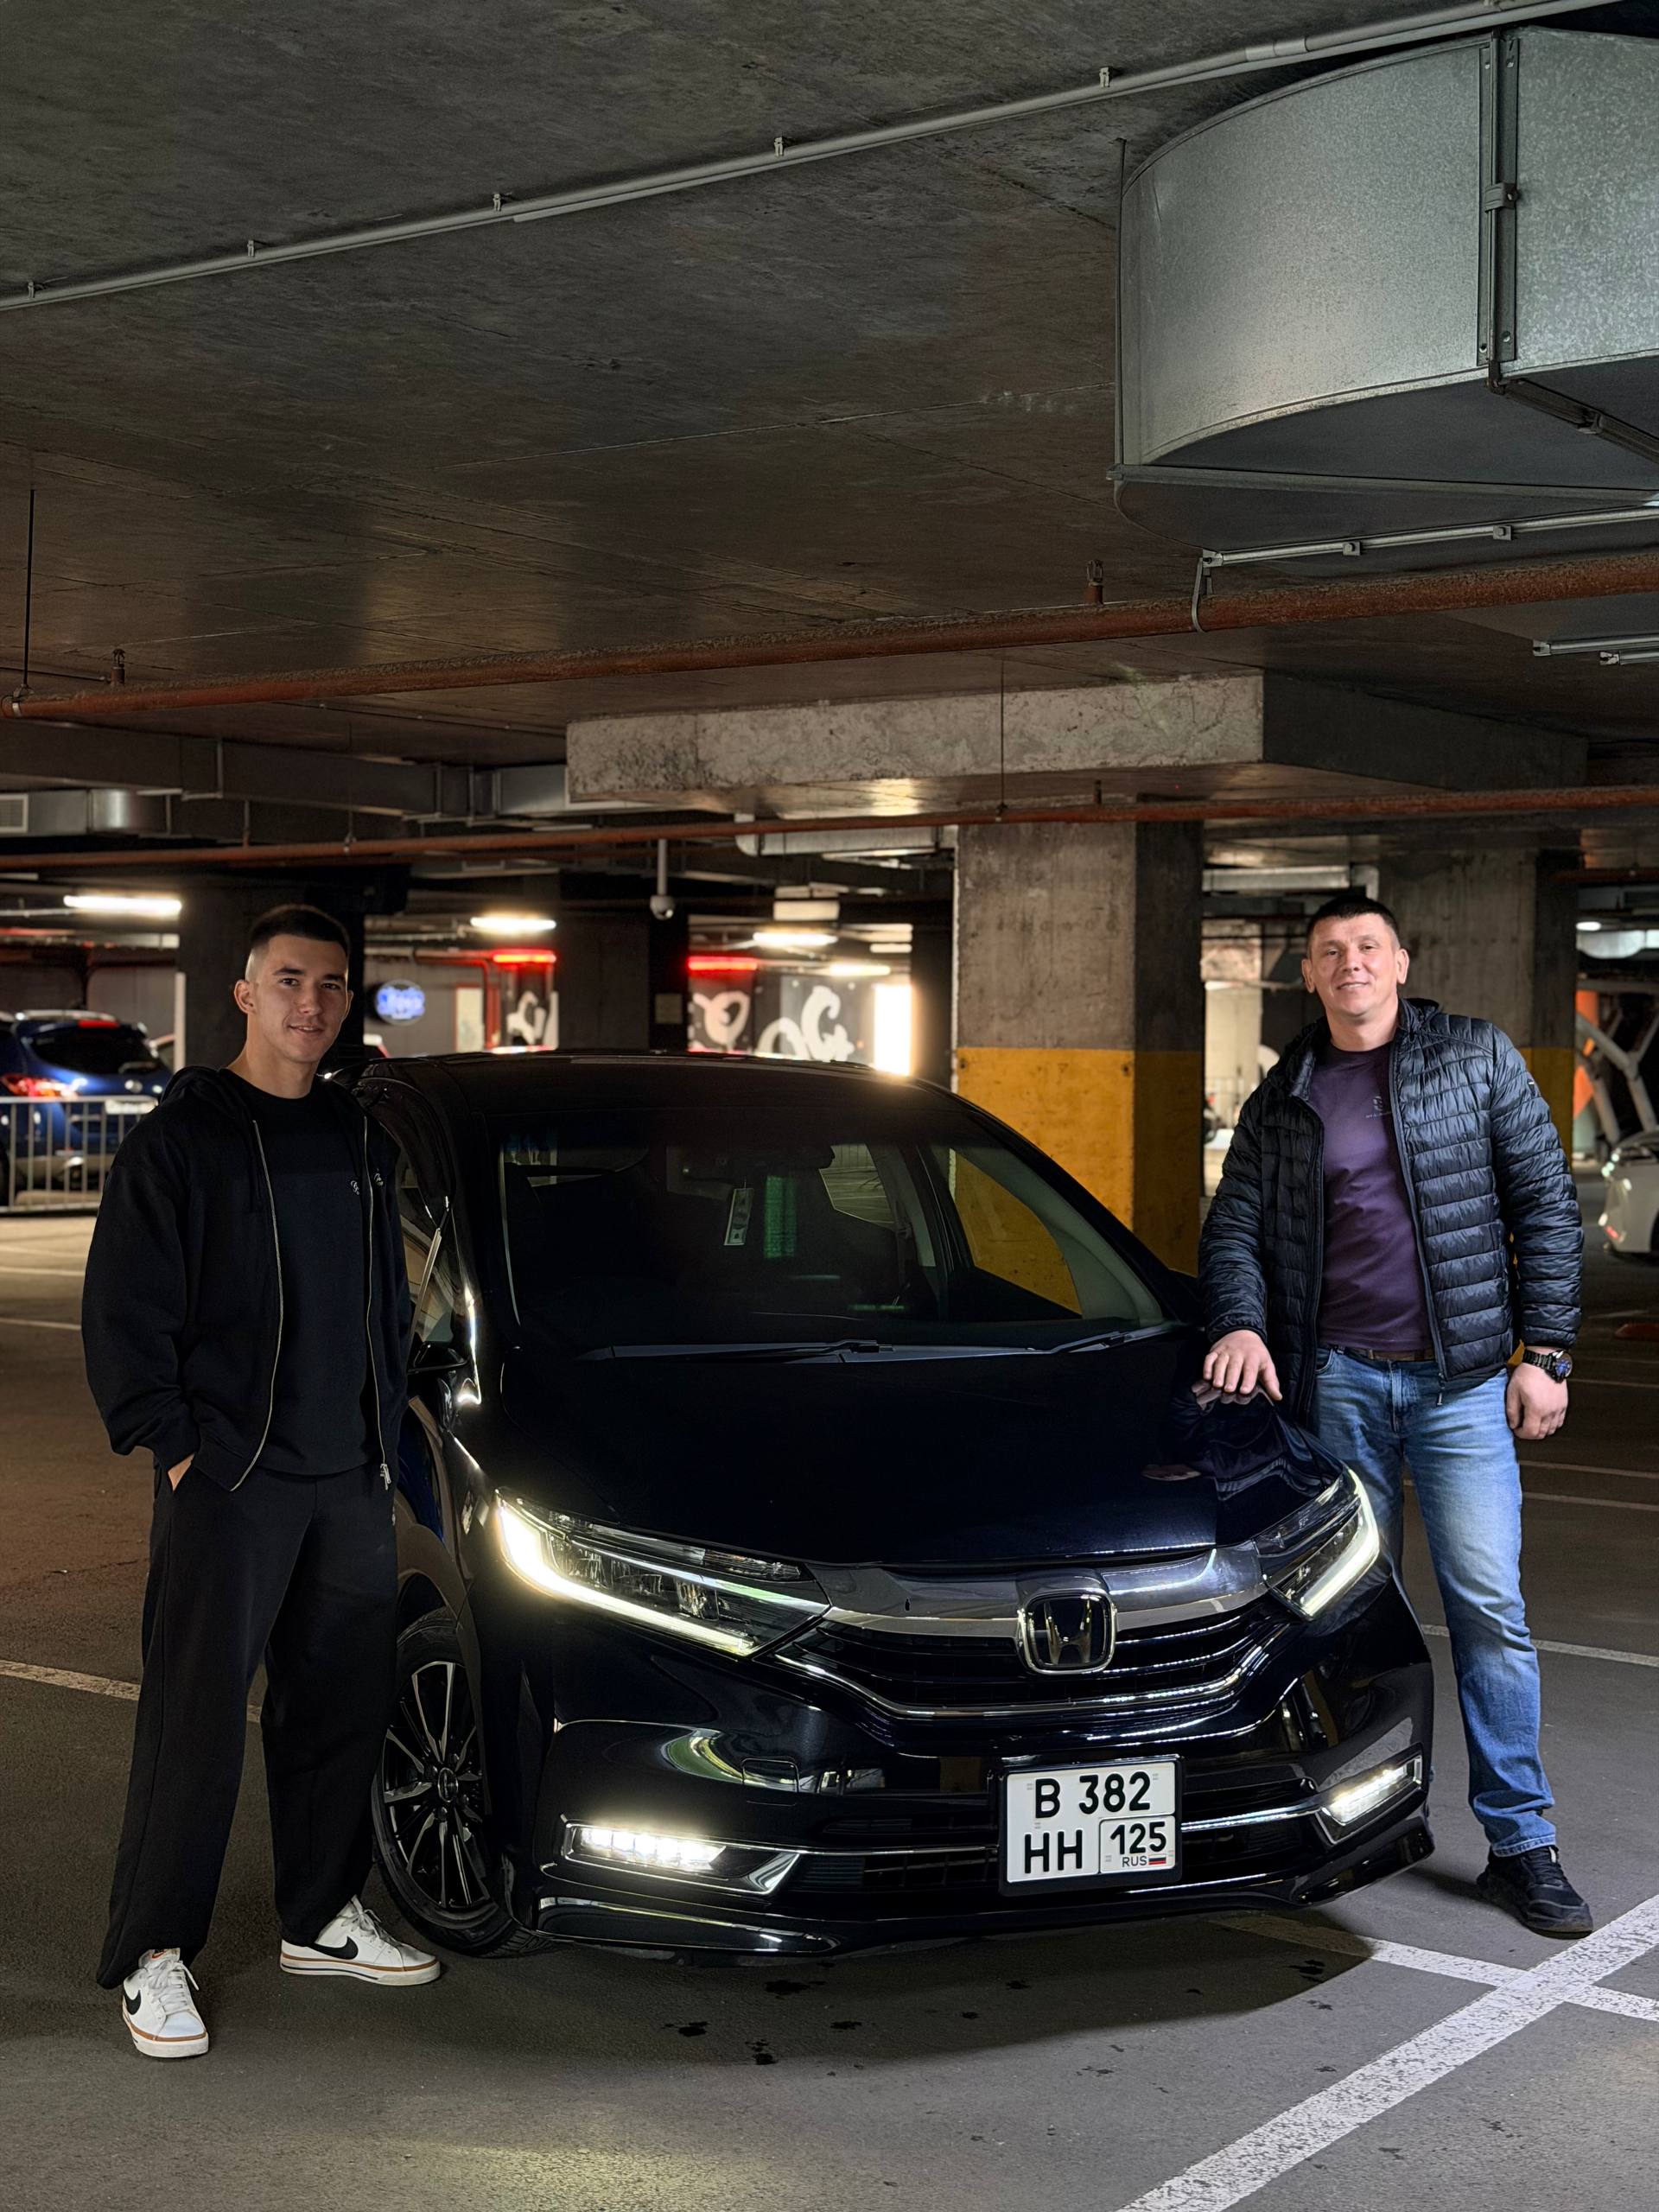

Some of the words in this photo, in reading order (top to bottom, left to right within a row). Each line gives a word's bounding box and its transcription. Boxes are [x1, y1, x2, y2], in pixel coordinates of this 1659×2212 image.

[1035, 1777, 1061, 1819] B
[1078, 1771, 1151, 1815] 382
[1024, 1829, 1083, 1874] HH
[1109, 1821, 1166, 1855] 125
[1122, 1855, 1147, 1867] RUS
